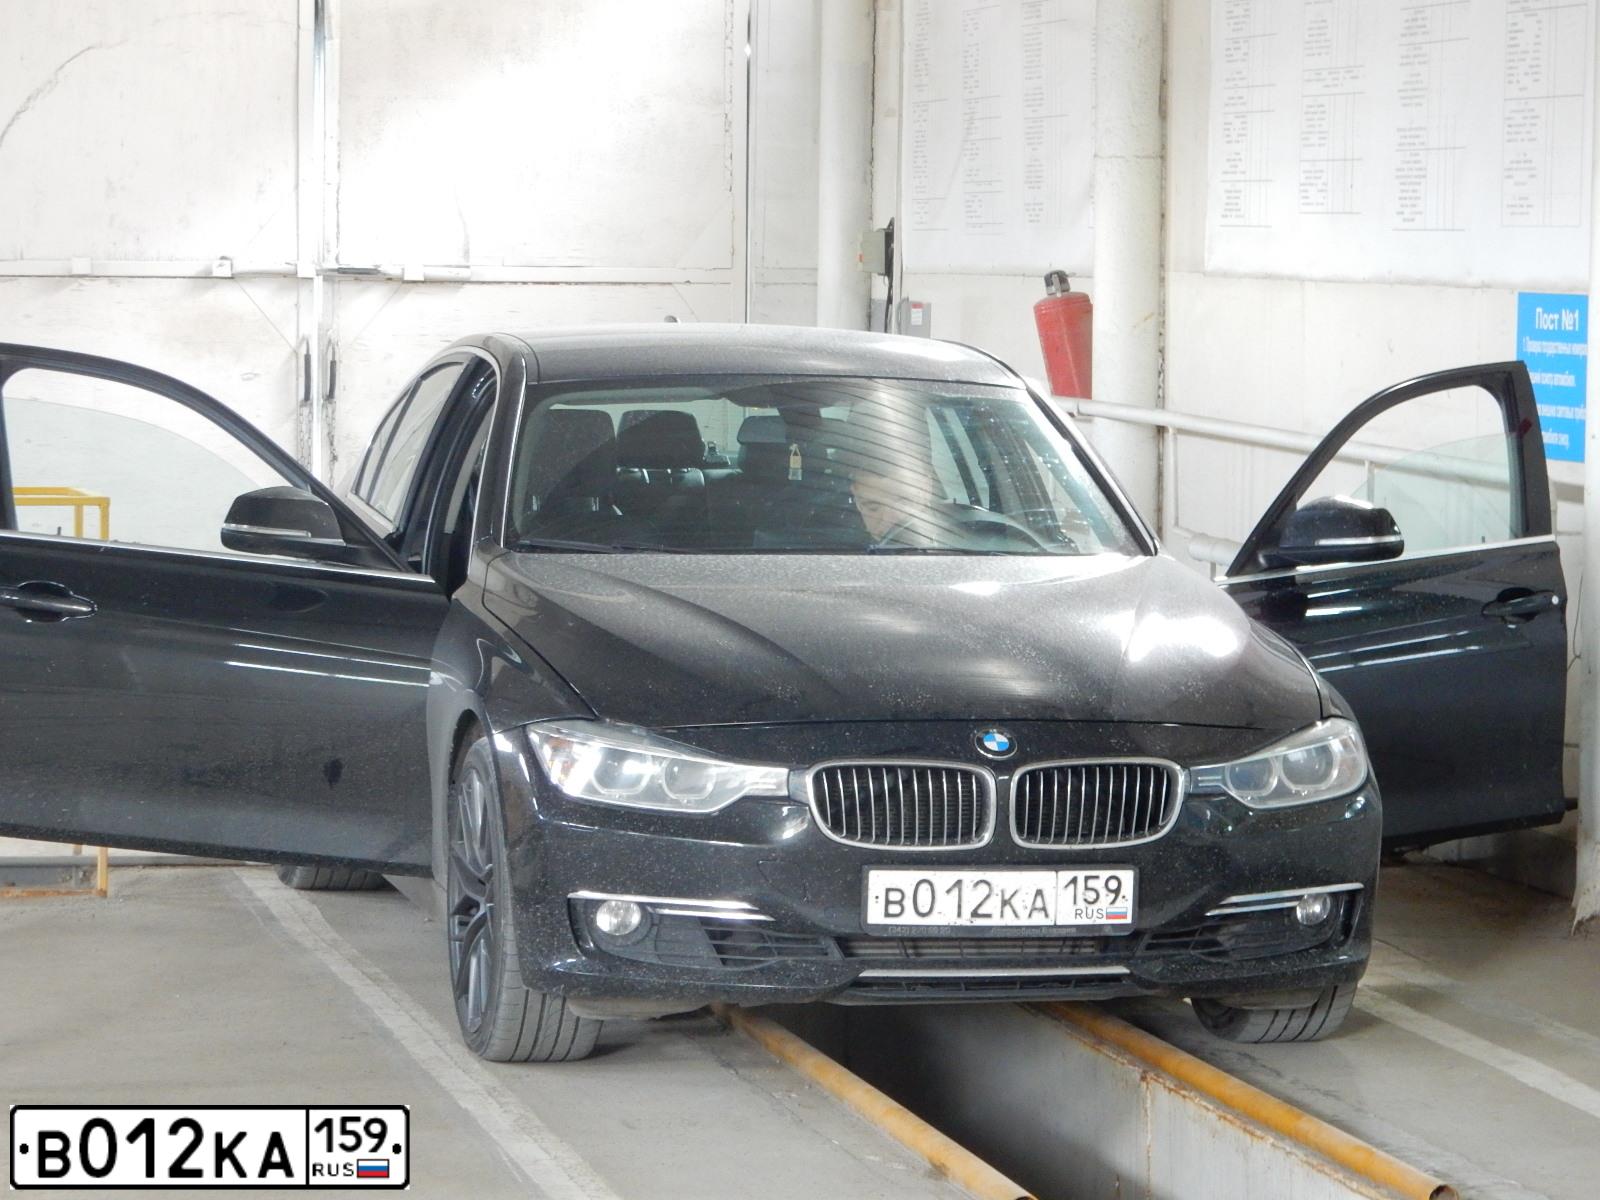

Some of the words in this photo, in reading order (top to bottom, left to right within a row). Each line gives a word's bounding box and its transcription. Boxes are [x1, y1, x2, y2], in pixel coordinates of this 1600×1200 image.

[1535, 307, 1560, 330] Пост
[1562, 308, 1580, 331] №1
[883, 878, 1050, 919] В012КА
[1064, 875, 1123, 906] 159
[1074, 907, 1104, 920] RUS
